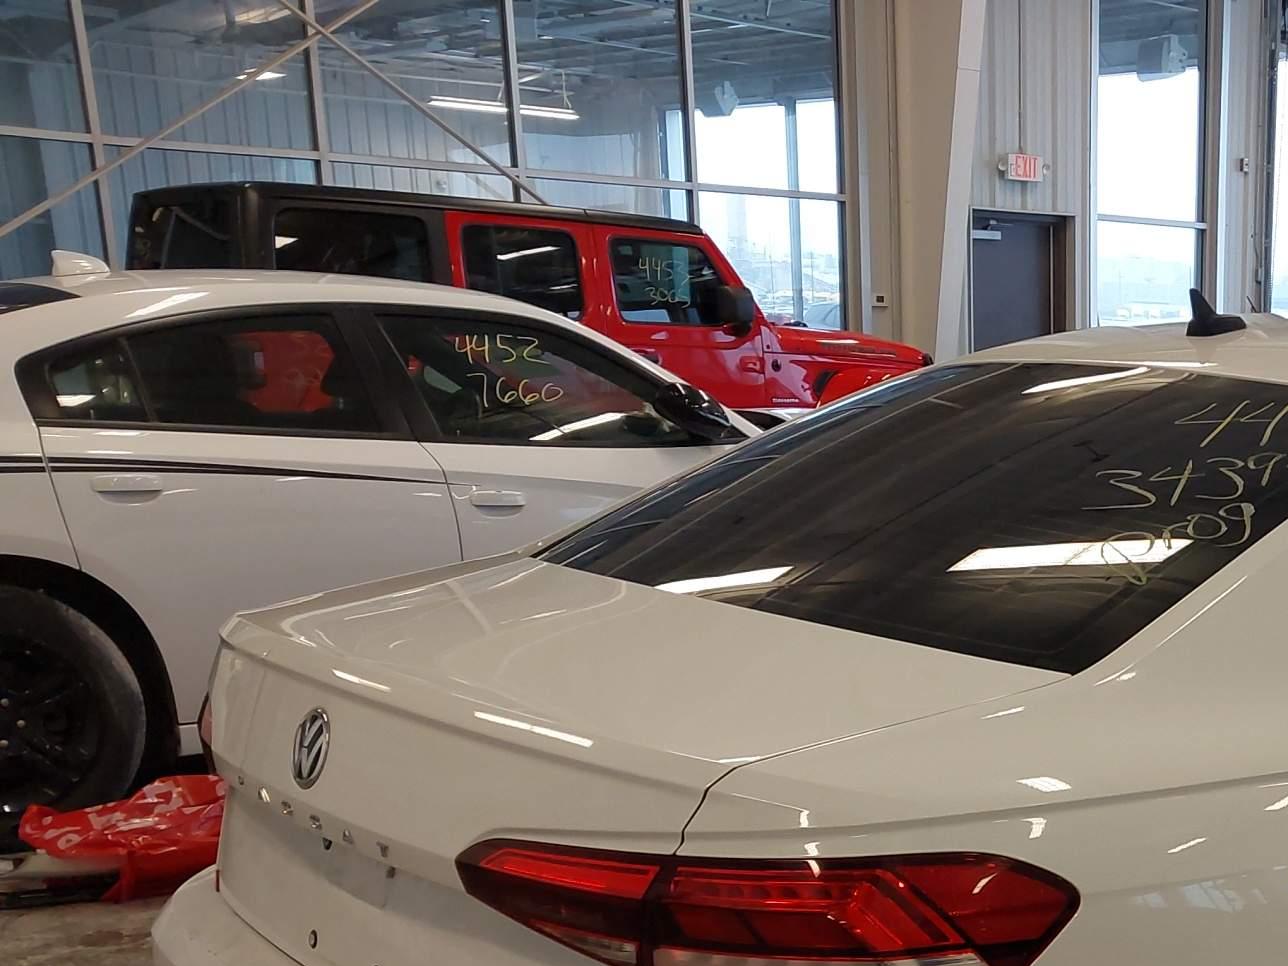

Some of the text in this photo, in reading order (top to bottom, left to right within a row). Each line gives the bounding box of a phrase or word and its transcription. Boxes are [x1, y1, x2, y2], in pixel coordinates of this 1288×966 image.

[1015, 155, 1038, 179] EXIT
[454, 332, 551, 364] 4452
[465, 372, 564, 408] 7660
